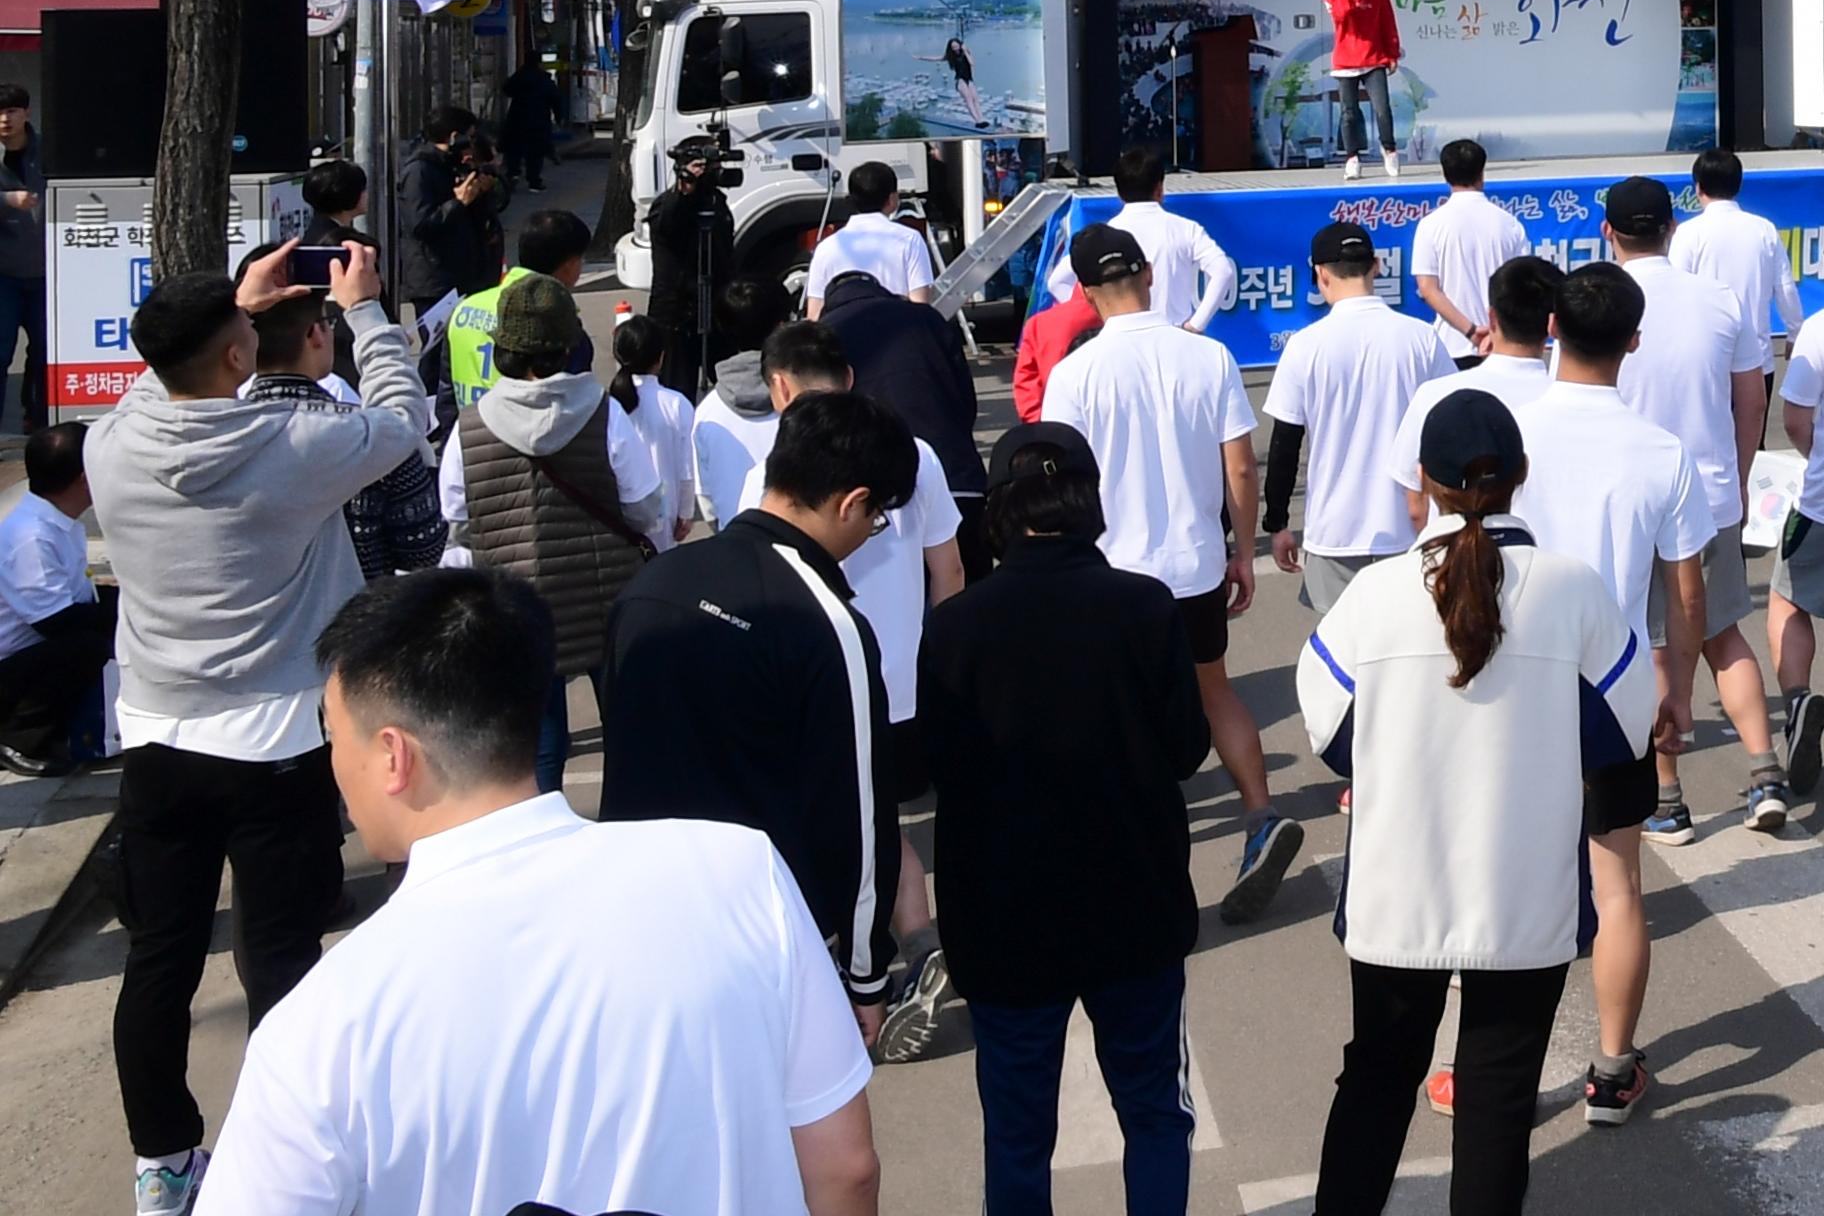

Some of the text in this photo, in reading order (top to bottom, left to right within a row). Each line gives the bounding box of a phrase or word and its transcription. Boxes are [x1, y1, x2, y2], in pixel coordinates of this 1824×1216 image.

[1416, 1, 1520, 41] 신나는 삶 밝은
[63, 226, 120, 248] 화천군
